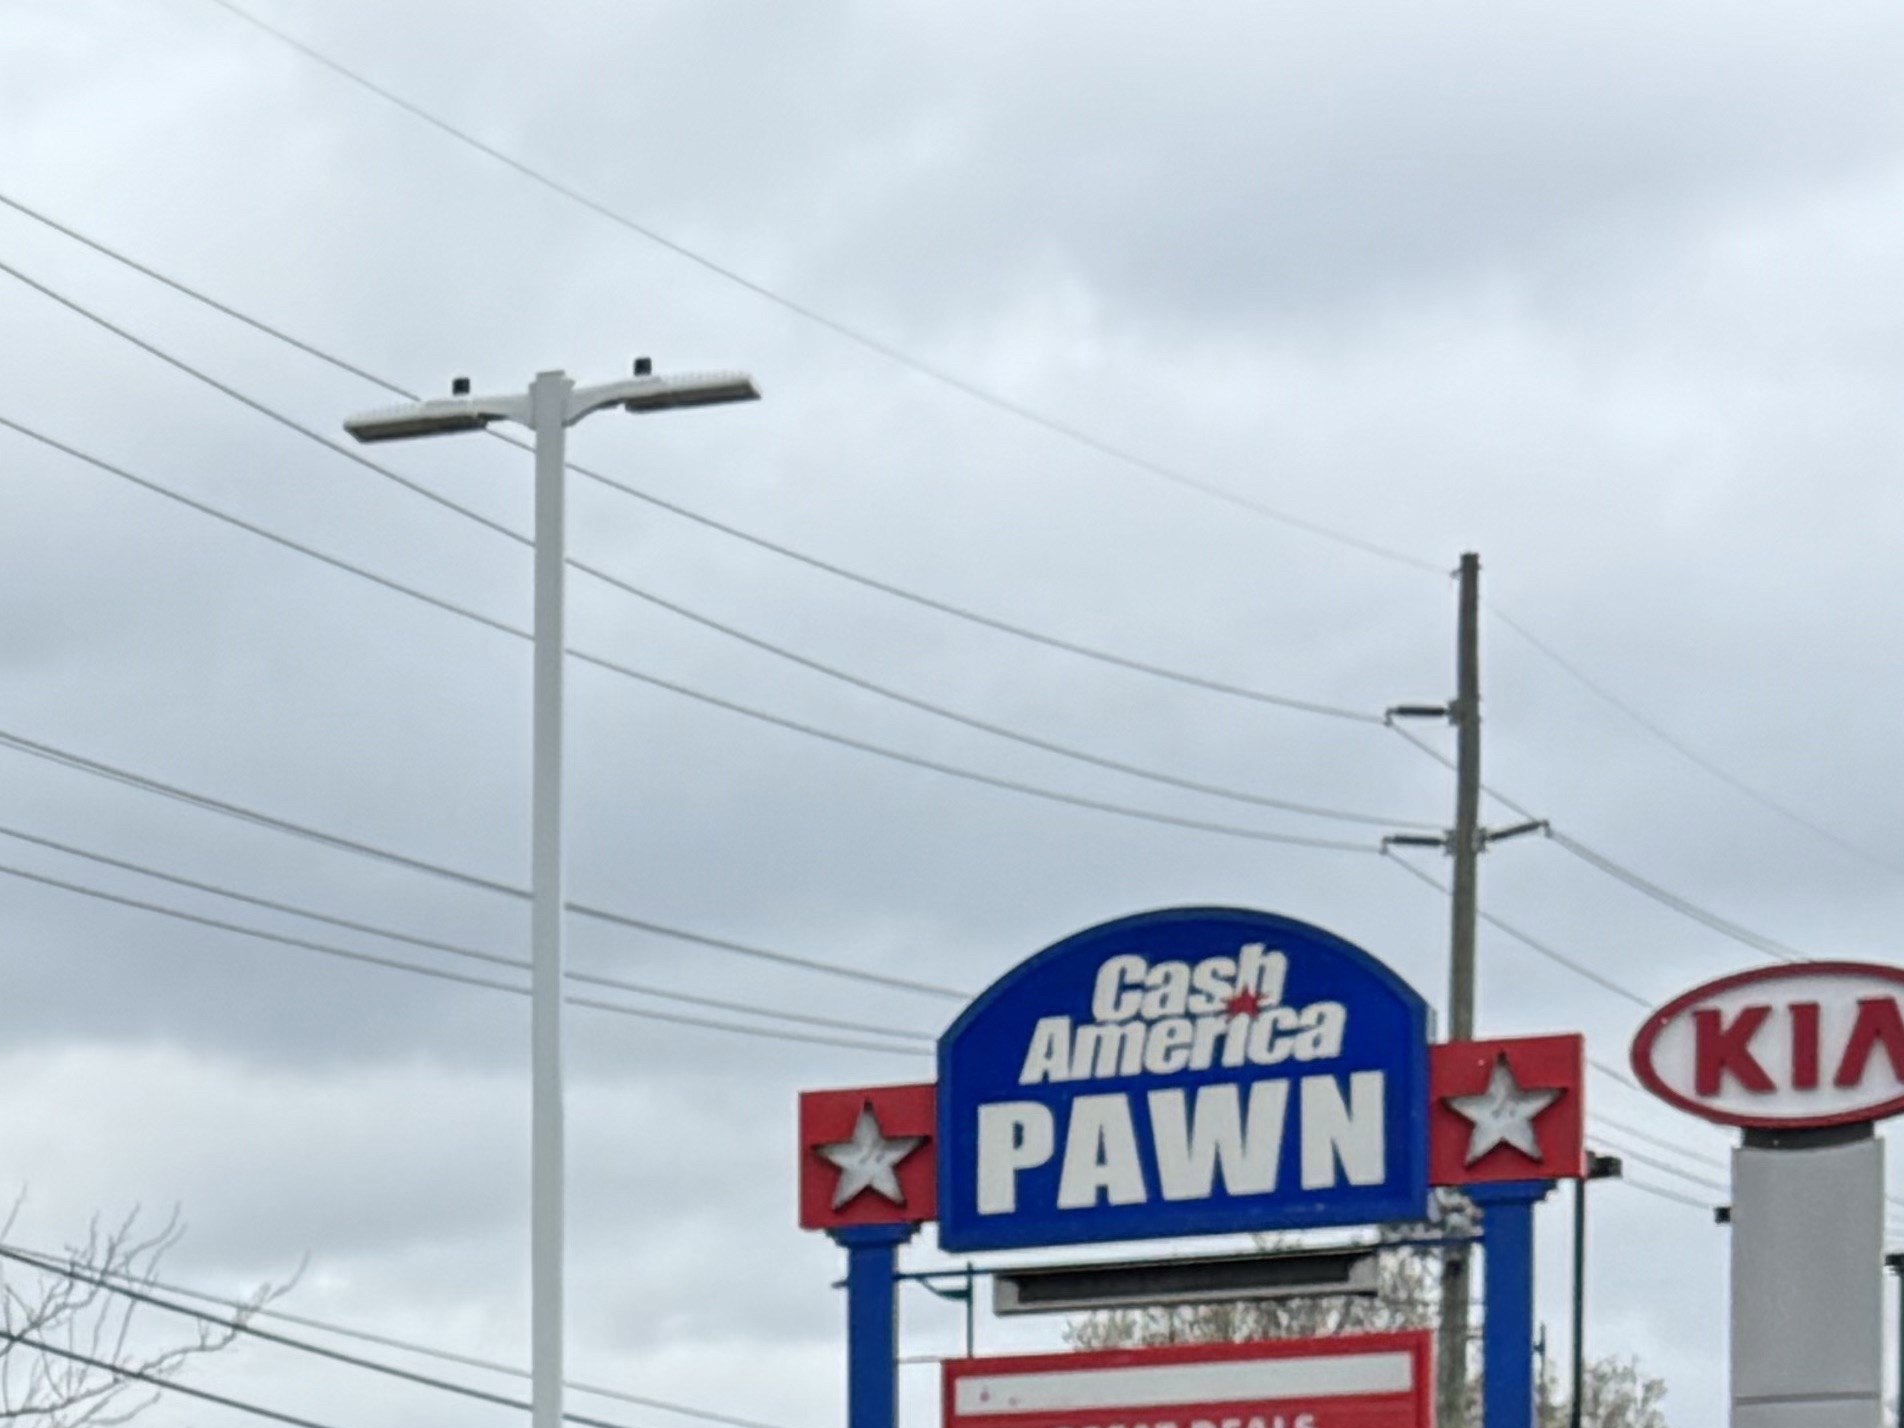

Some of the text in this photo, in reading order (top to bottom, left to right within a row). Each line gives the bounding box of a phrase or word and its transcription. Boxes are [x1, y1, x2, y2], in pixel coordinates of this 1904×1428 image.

[1091, 942, 1288, 1023] Cash
[1018, 1000, 1347, 1085] America
[1694, 997, 1904, 1096] KIA
[977, 1070, 1386, 1216] PAWN
